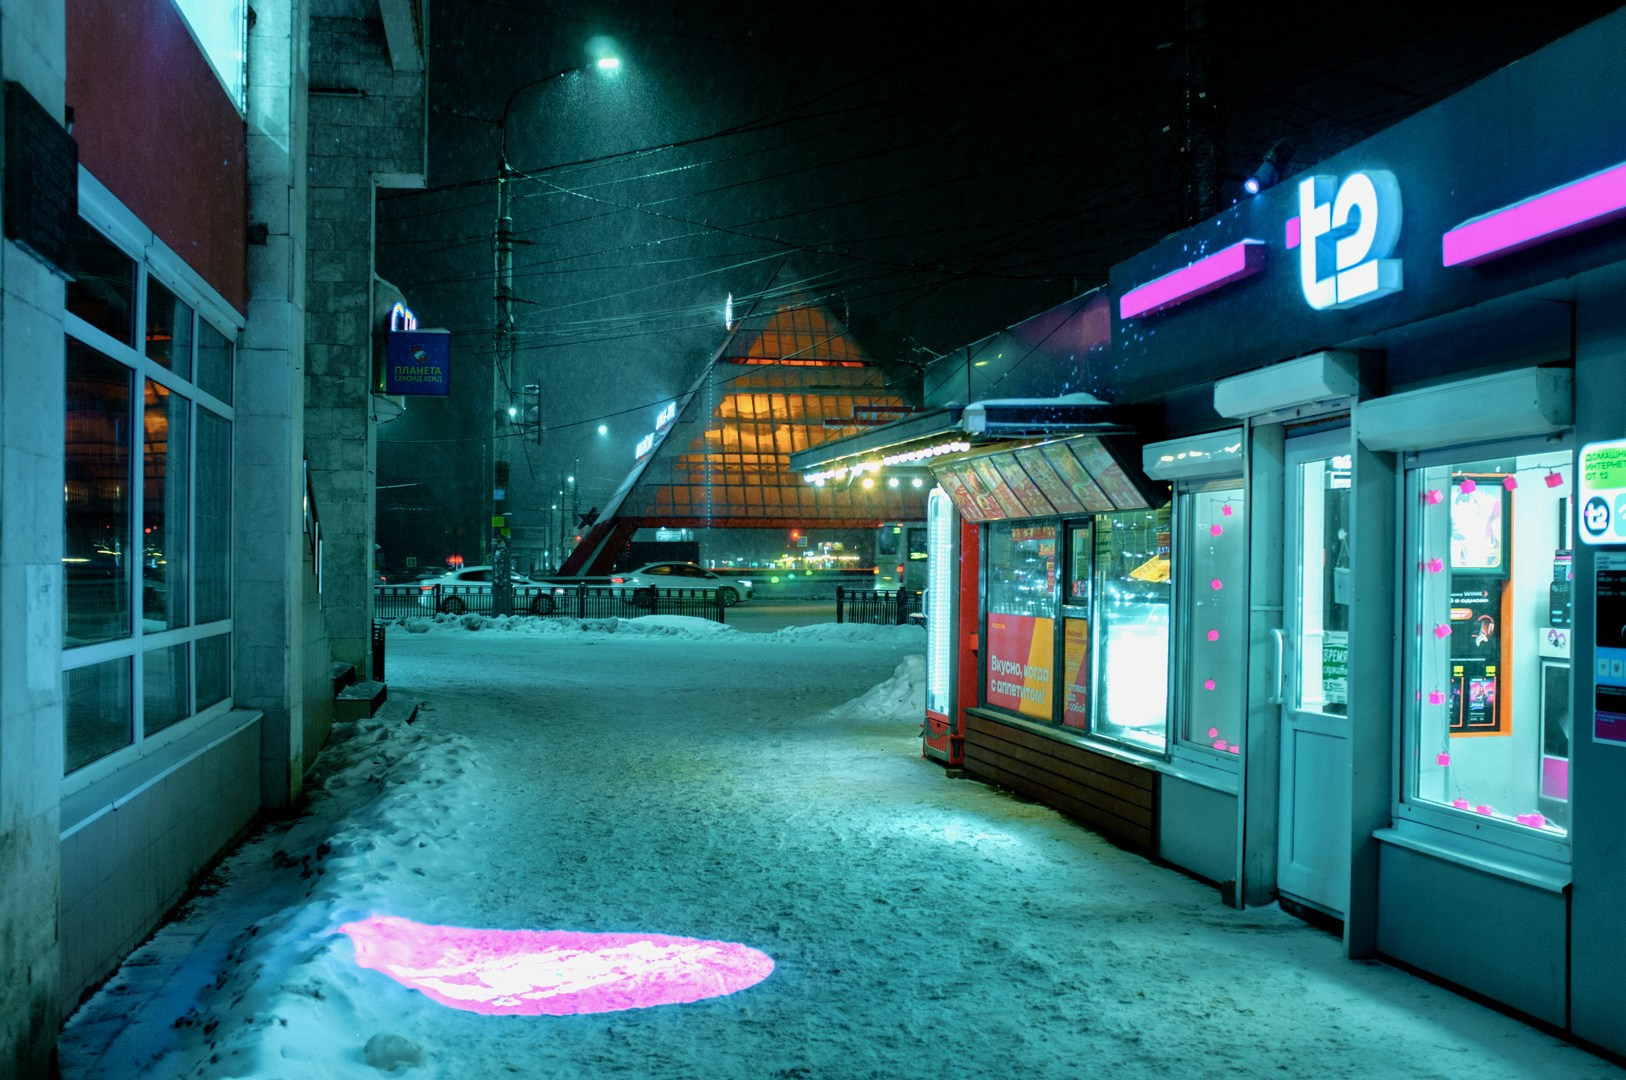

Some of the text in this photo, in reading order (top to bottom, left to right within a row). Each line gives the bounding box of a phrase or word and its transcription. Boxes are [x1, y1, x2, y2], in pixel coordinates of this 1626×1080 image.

[1286, 171, 1398, 310] t2
[395, 366, 442, 375] ПЛАНЕТА
[395, 375, 442, 383] СЕКОНД ХЕНД
[1585, 472, 1596, 480] ОТ
[991, 655, 1022, 679] Вкусно,
[1024, 664, 1049, 683] когда
[991, 679, 1045, 704] с аппетитом!
